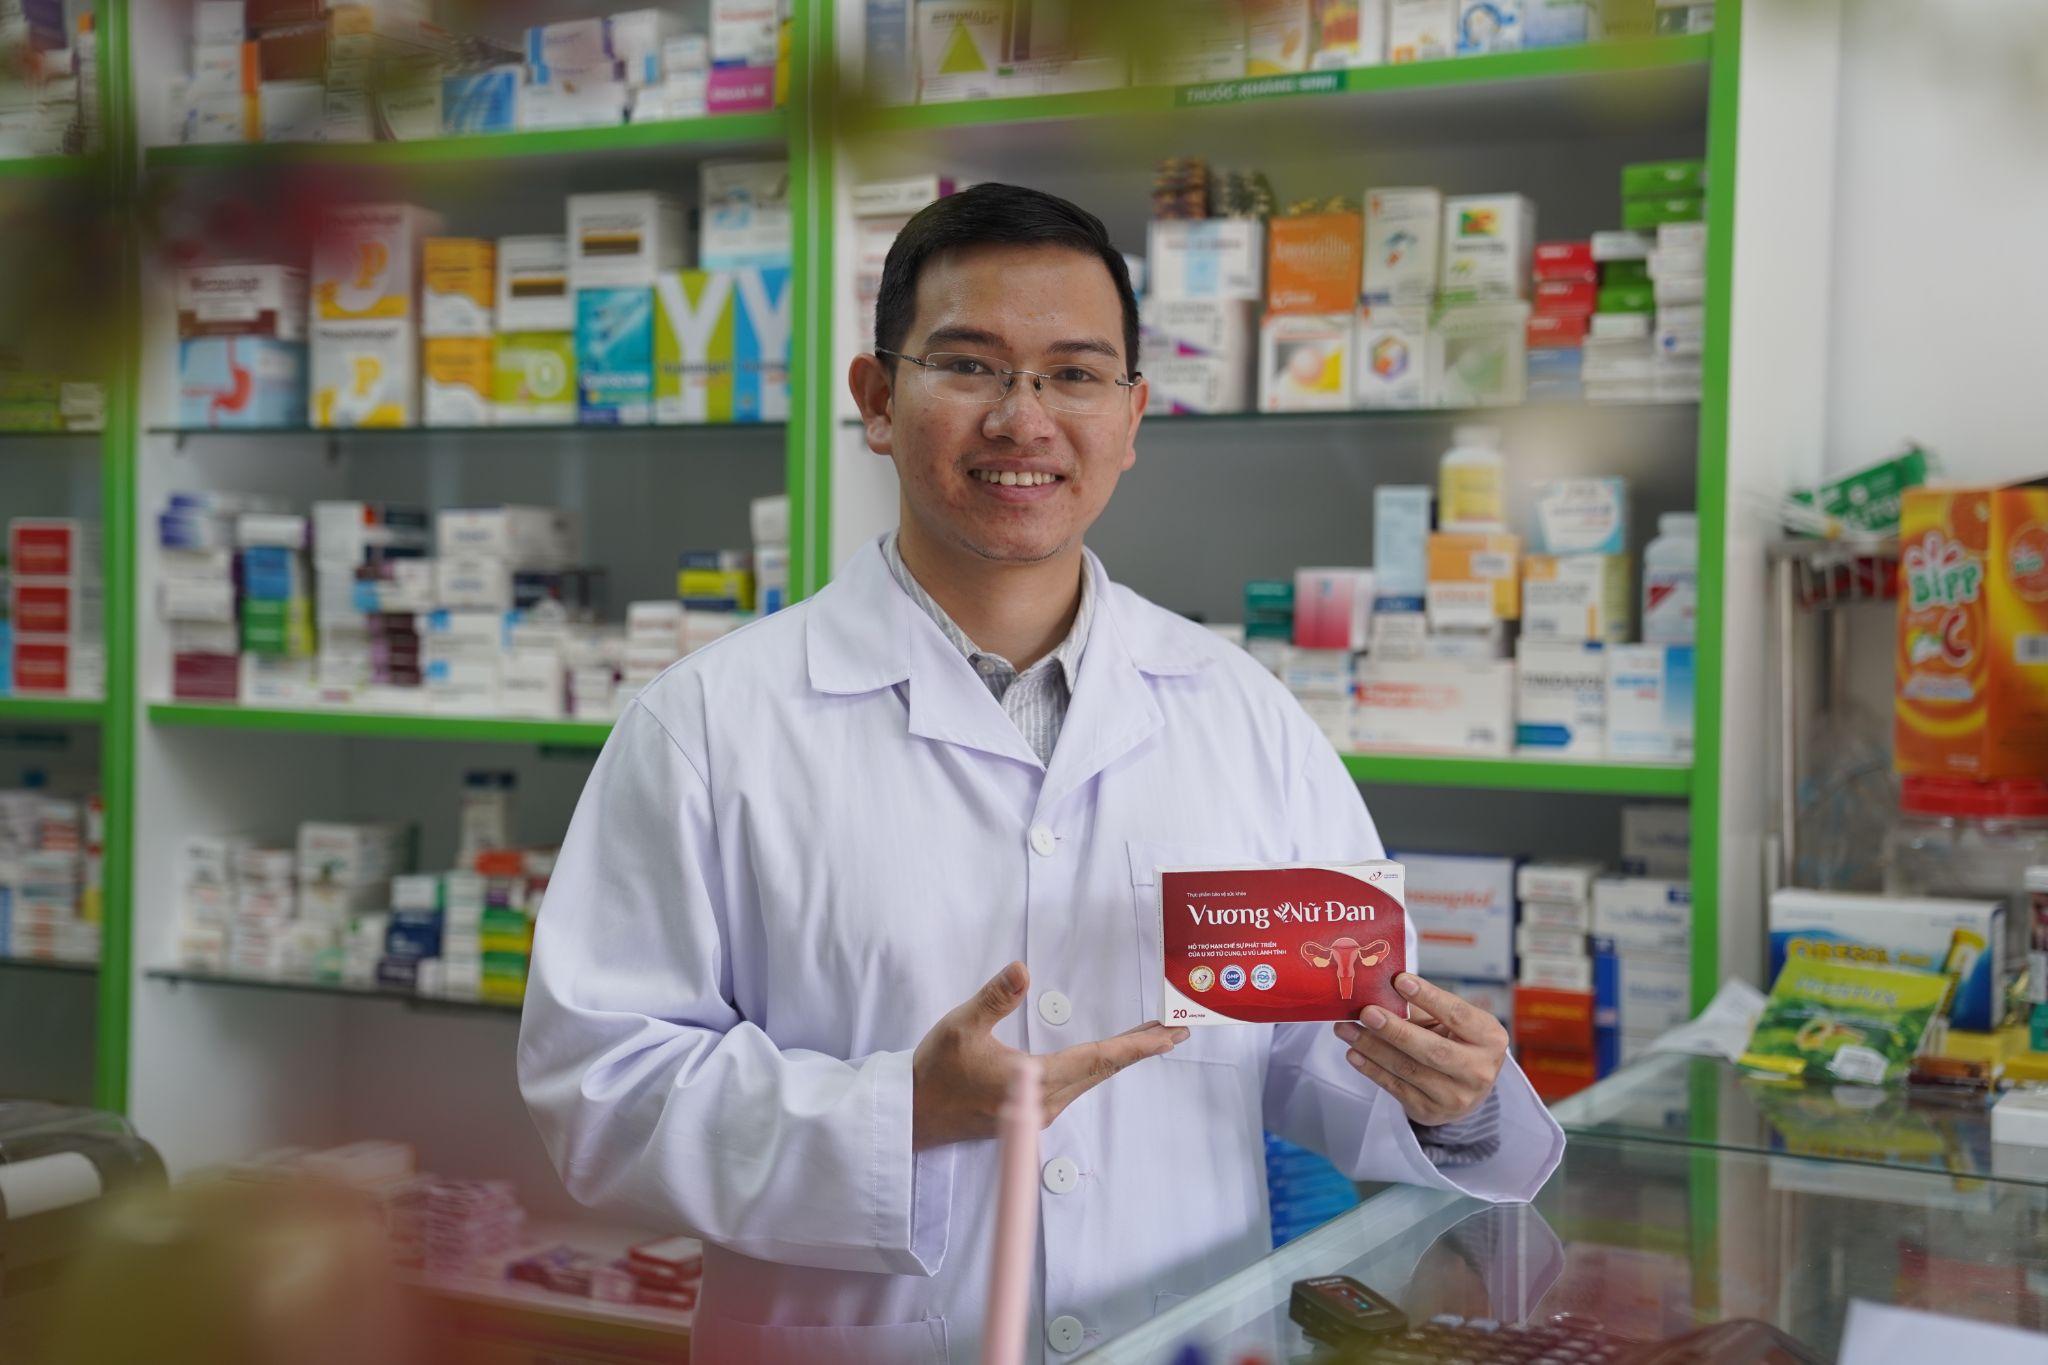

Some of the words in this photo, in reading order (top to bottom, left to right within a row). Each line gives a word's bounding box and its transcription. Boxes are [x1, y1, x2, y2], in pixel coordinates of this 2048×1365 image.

[1187, 904, 1270, 929] Vương
[1276, 901, 1321, 922] Nữ
[1325, 901, 1375, 922] Đan
[1173, 1009, 1187, 1019] 20
